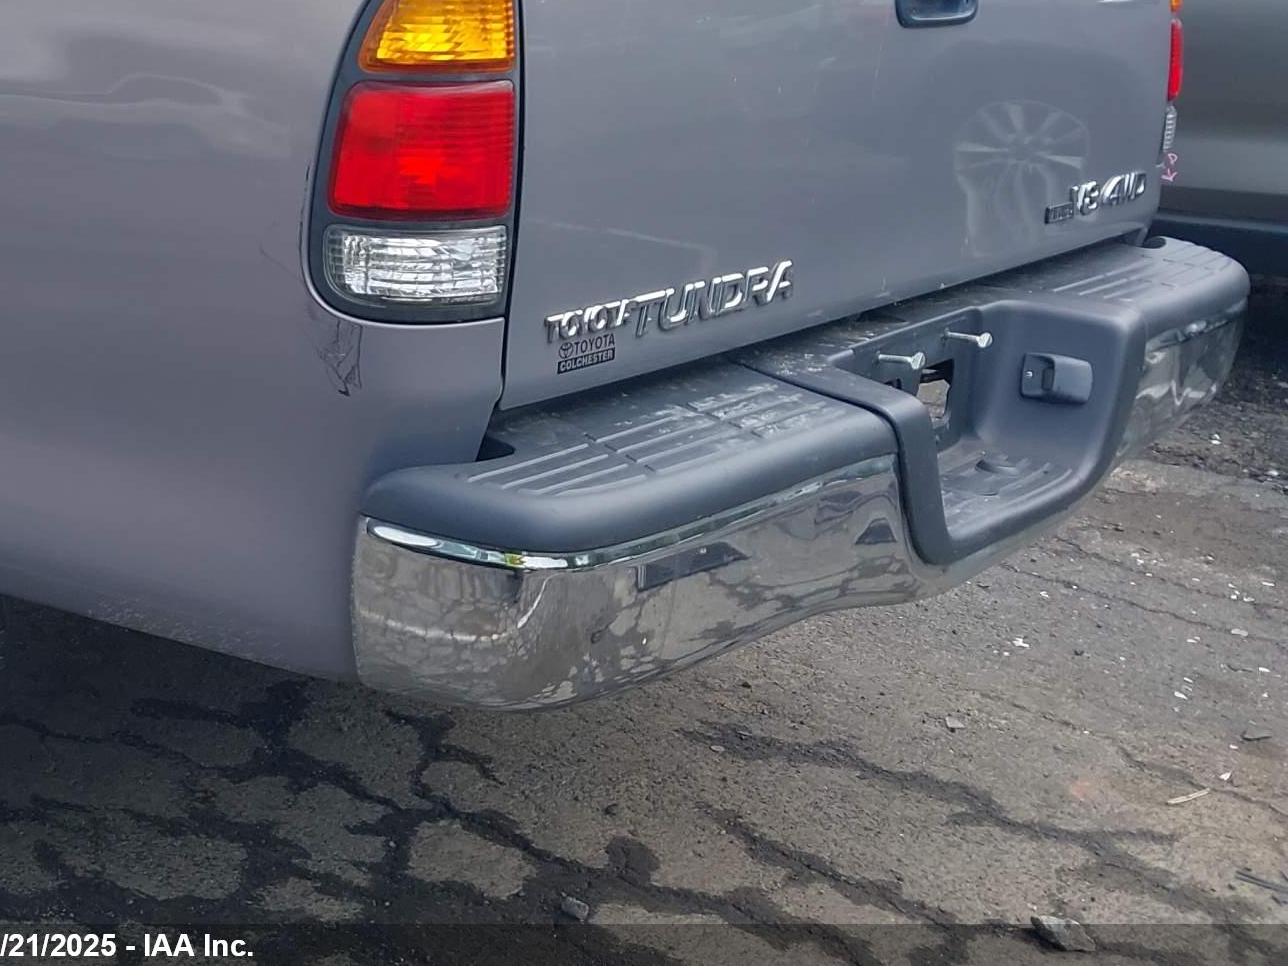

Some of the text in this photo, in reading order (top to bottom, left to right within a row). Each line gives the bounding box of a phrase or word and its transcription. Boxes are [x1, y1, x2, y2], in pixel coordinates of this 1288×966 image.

[629, 259, 793, 338] TUNDRA
[573, 333, 616, 356] TOYOTA
[558, 349, 615, 372] COLCHESTER
